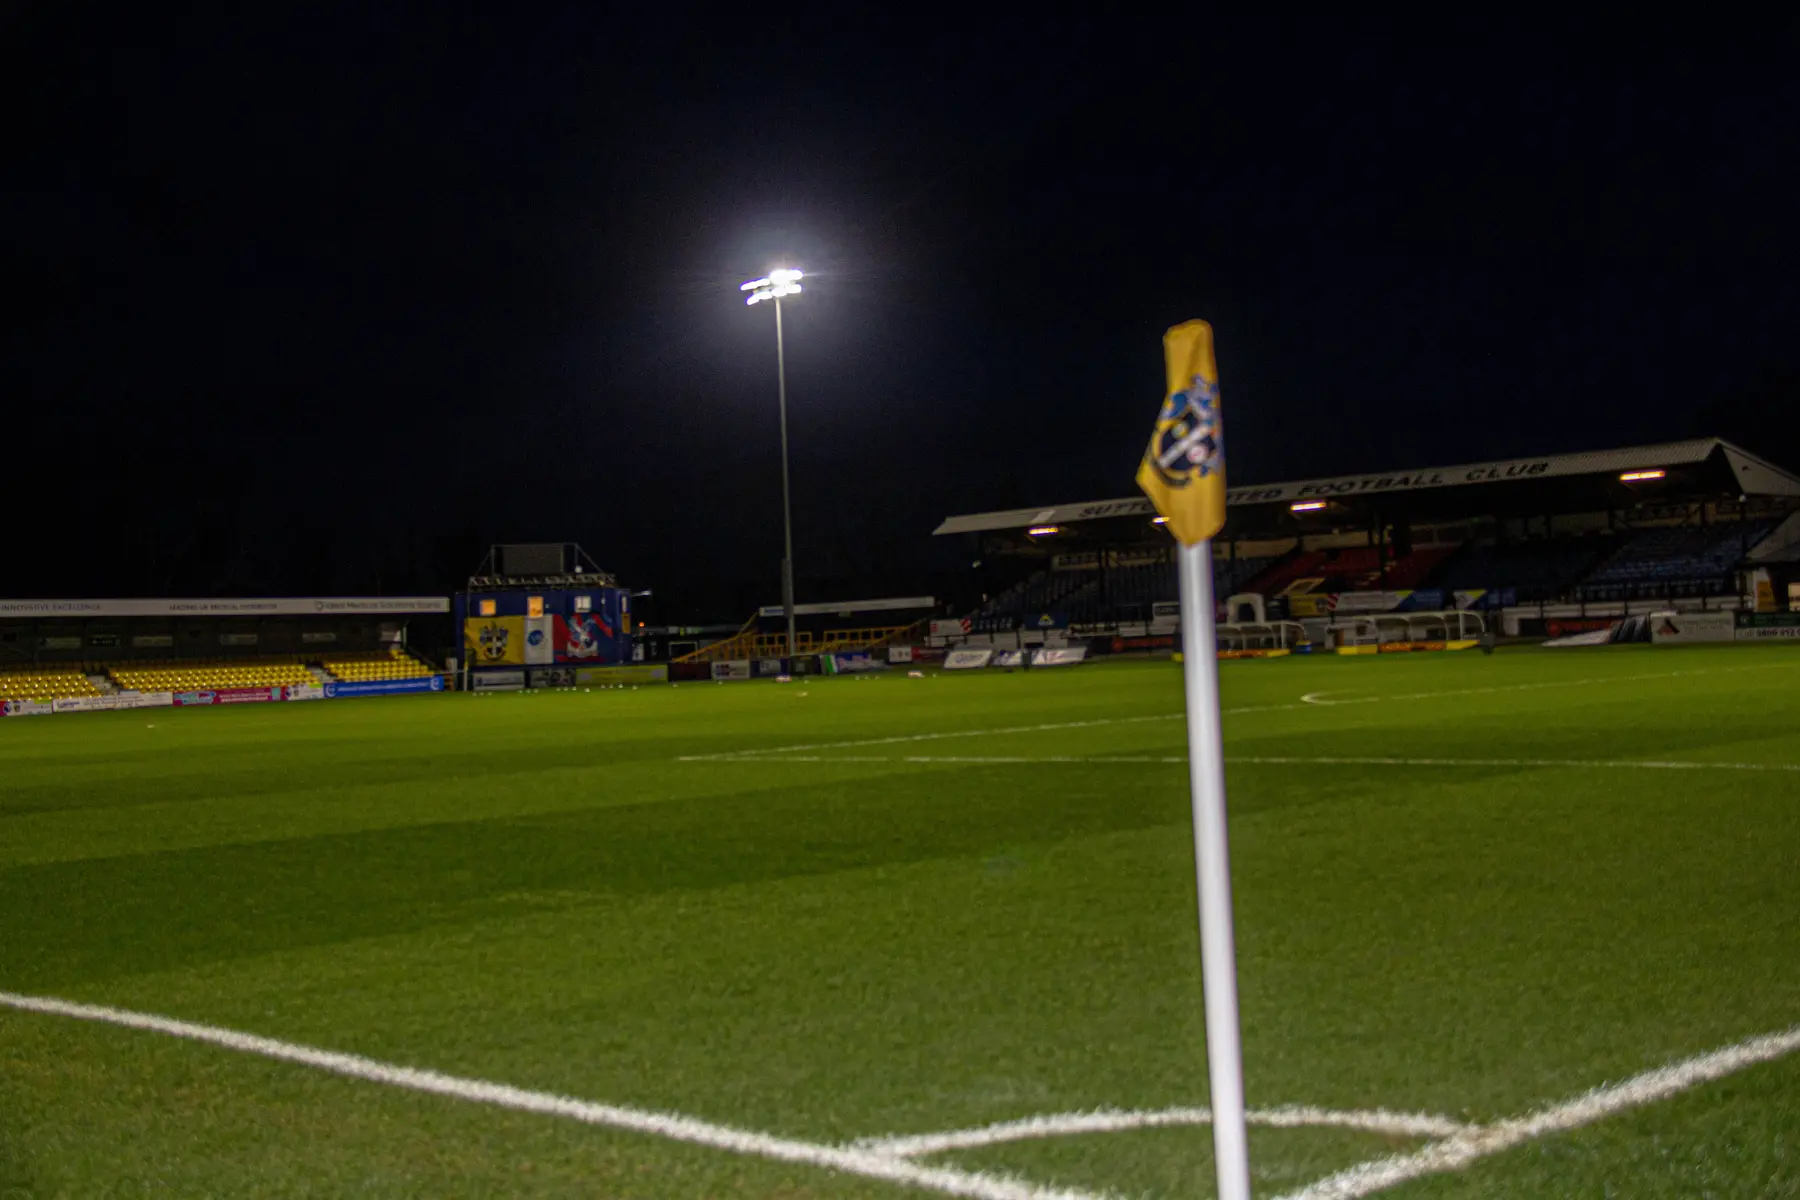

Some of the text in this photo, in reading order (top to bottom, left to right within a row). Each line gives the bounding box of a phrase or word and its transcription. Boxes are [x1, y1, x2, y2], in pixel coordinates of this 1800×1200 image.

[1079, 502, 1156, 518] SUTTO
[1298, 473, 1444, 496] FOOTBALL
[1466, 462, 1548, 482] CLUB
[1, 603, 101, 612] INNOVATIVE EXCELLENCE
